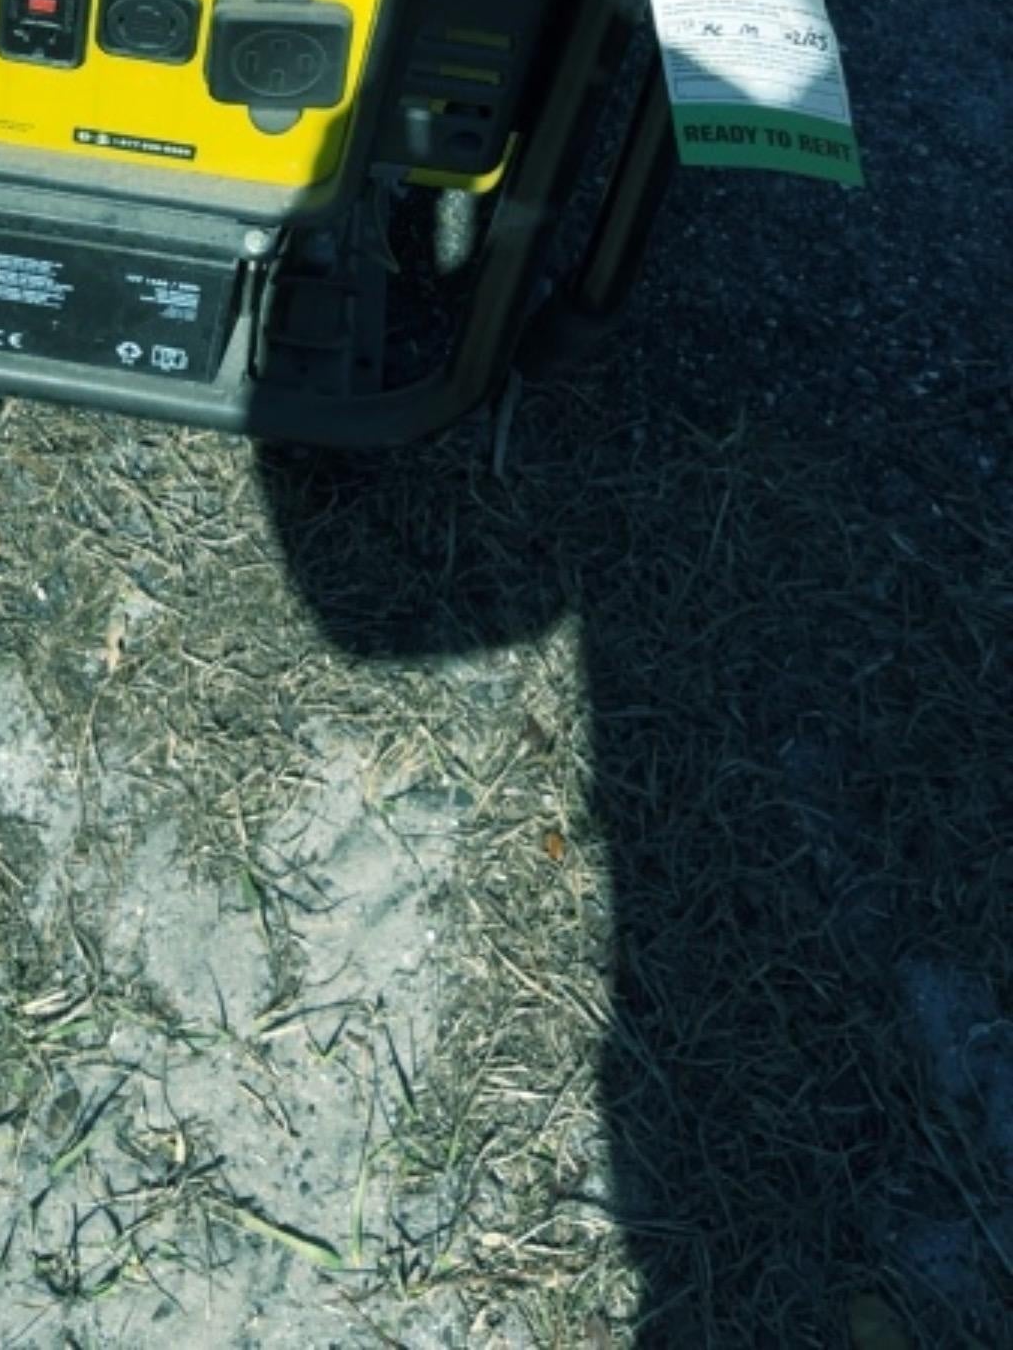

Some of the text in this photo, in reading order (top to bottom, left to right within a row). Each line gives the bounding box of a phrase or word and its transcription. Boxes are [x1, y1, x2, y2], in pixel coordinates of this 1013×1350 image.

[683, 124, 851, 162] READY TO RENT
